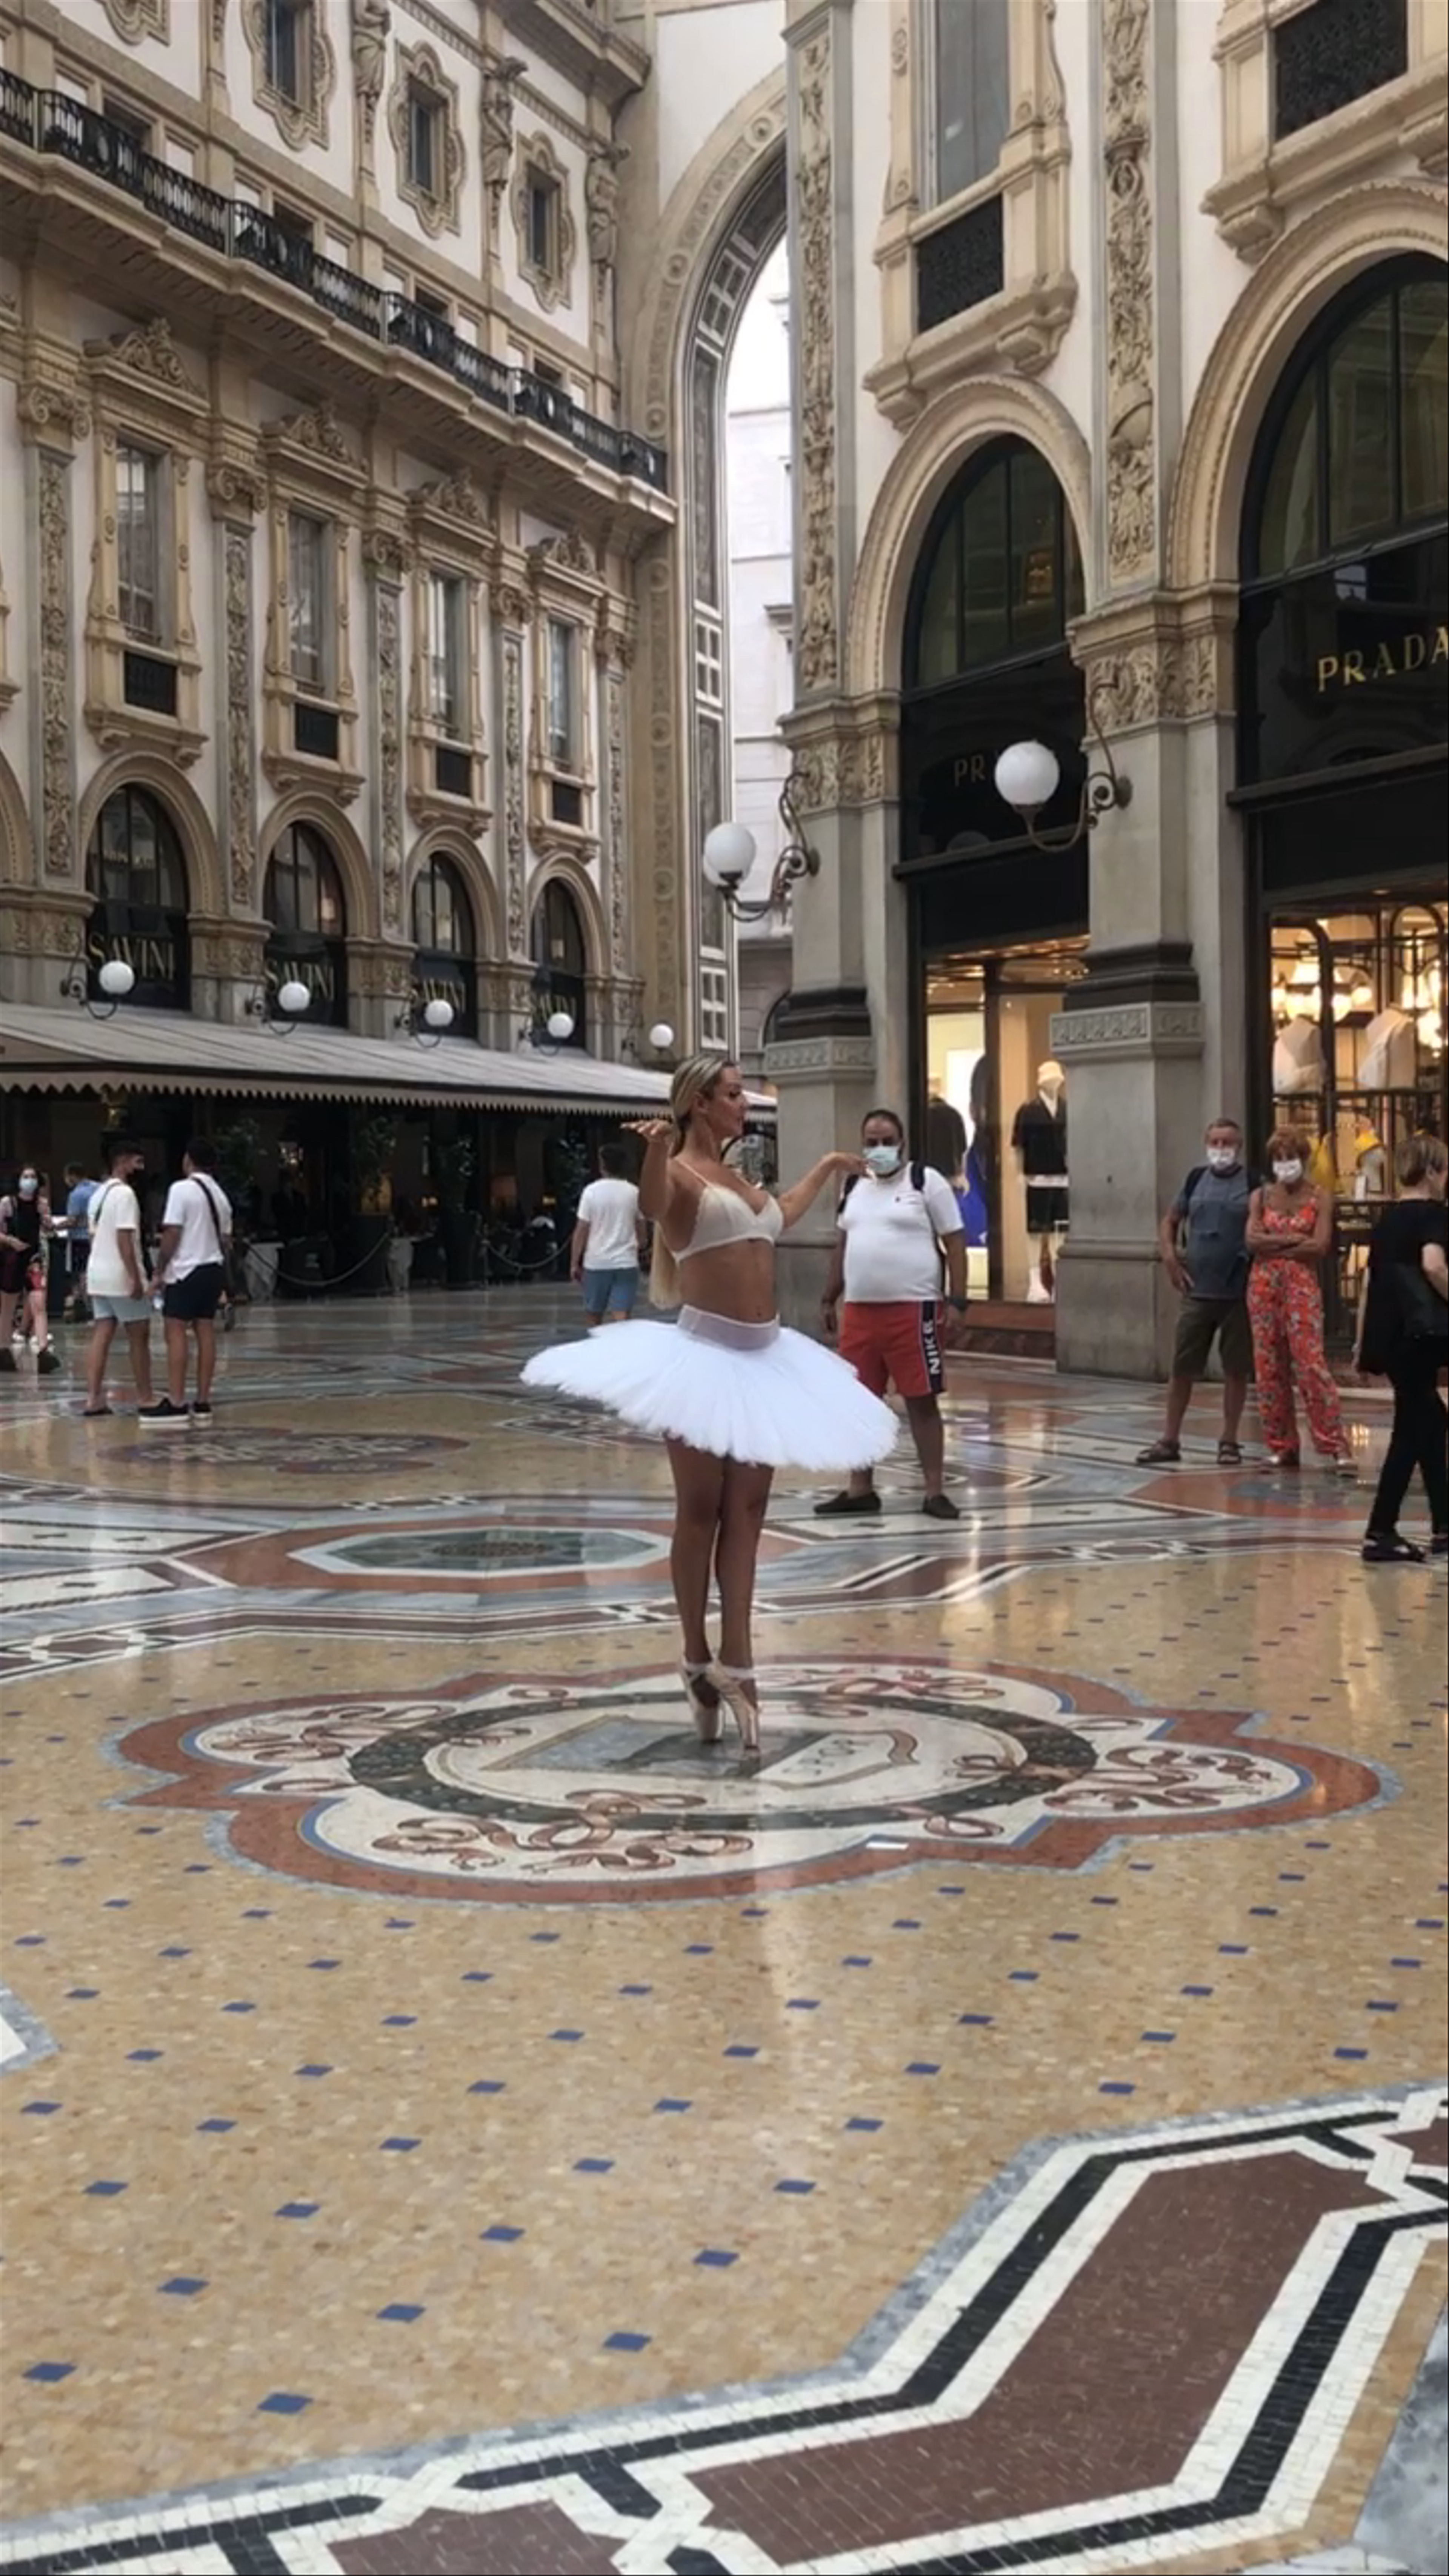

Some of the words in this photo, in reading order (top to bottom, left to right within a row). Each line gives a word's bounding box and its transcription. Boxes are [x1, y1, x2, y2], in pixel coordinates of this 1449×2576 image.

[1318, 626, 1449, 692] PRADA
[954, 751, 997, 787] PR
[923, 1320, 940, 1374] NIKE
